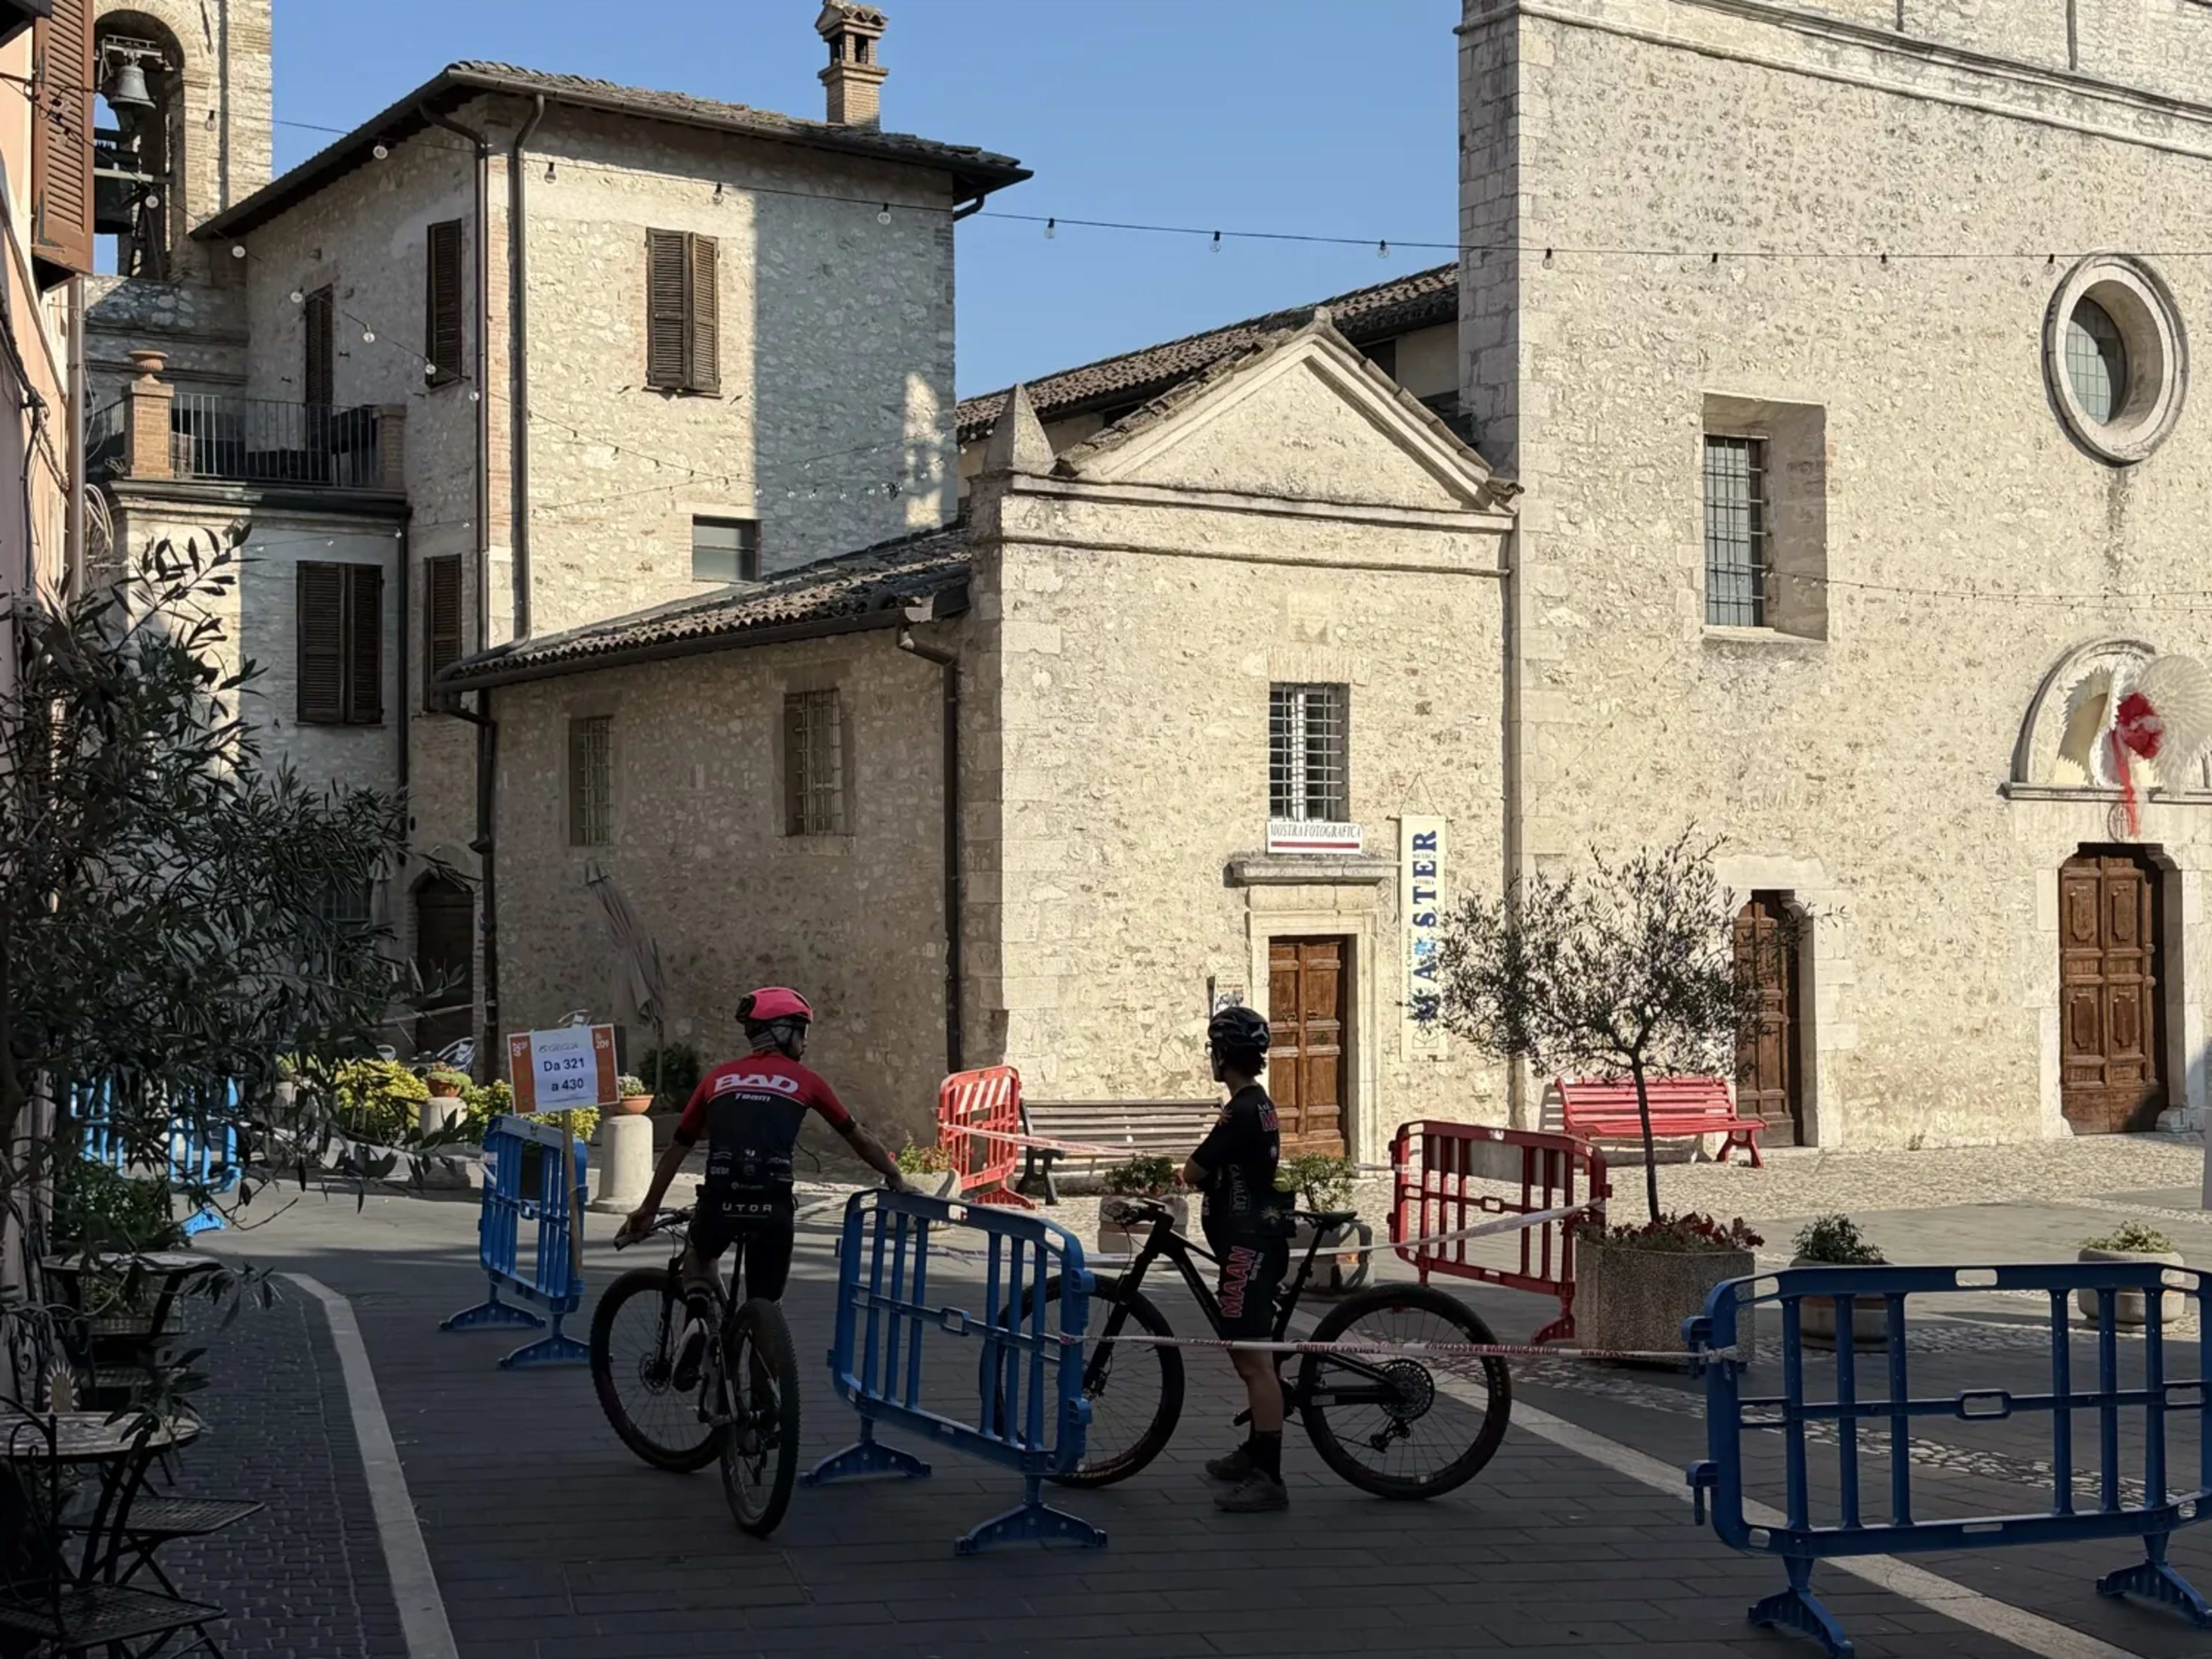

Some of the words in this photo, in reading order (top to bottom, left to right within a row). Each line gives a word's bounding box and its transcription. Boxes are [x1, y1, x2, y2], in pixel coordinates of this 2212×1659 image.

[1271, 824, 1302, 836] MOSTRA
[1304, 824, 1361, 838] FOTOGRAFICA
[543, 1060, 561, 1072] Da
[563, 1058, 585, 1070] 321
[551, 1083, 559, 1092] a
[561, 1078, 585, 1090] 430
[714, 1073, 799, 1094] BAD
[1221, 1245, 1256, 1317] MAAN
